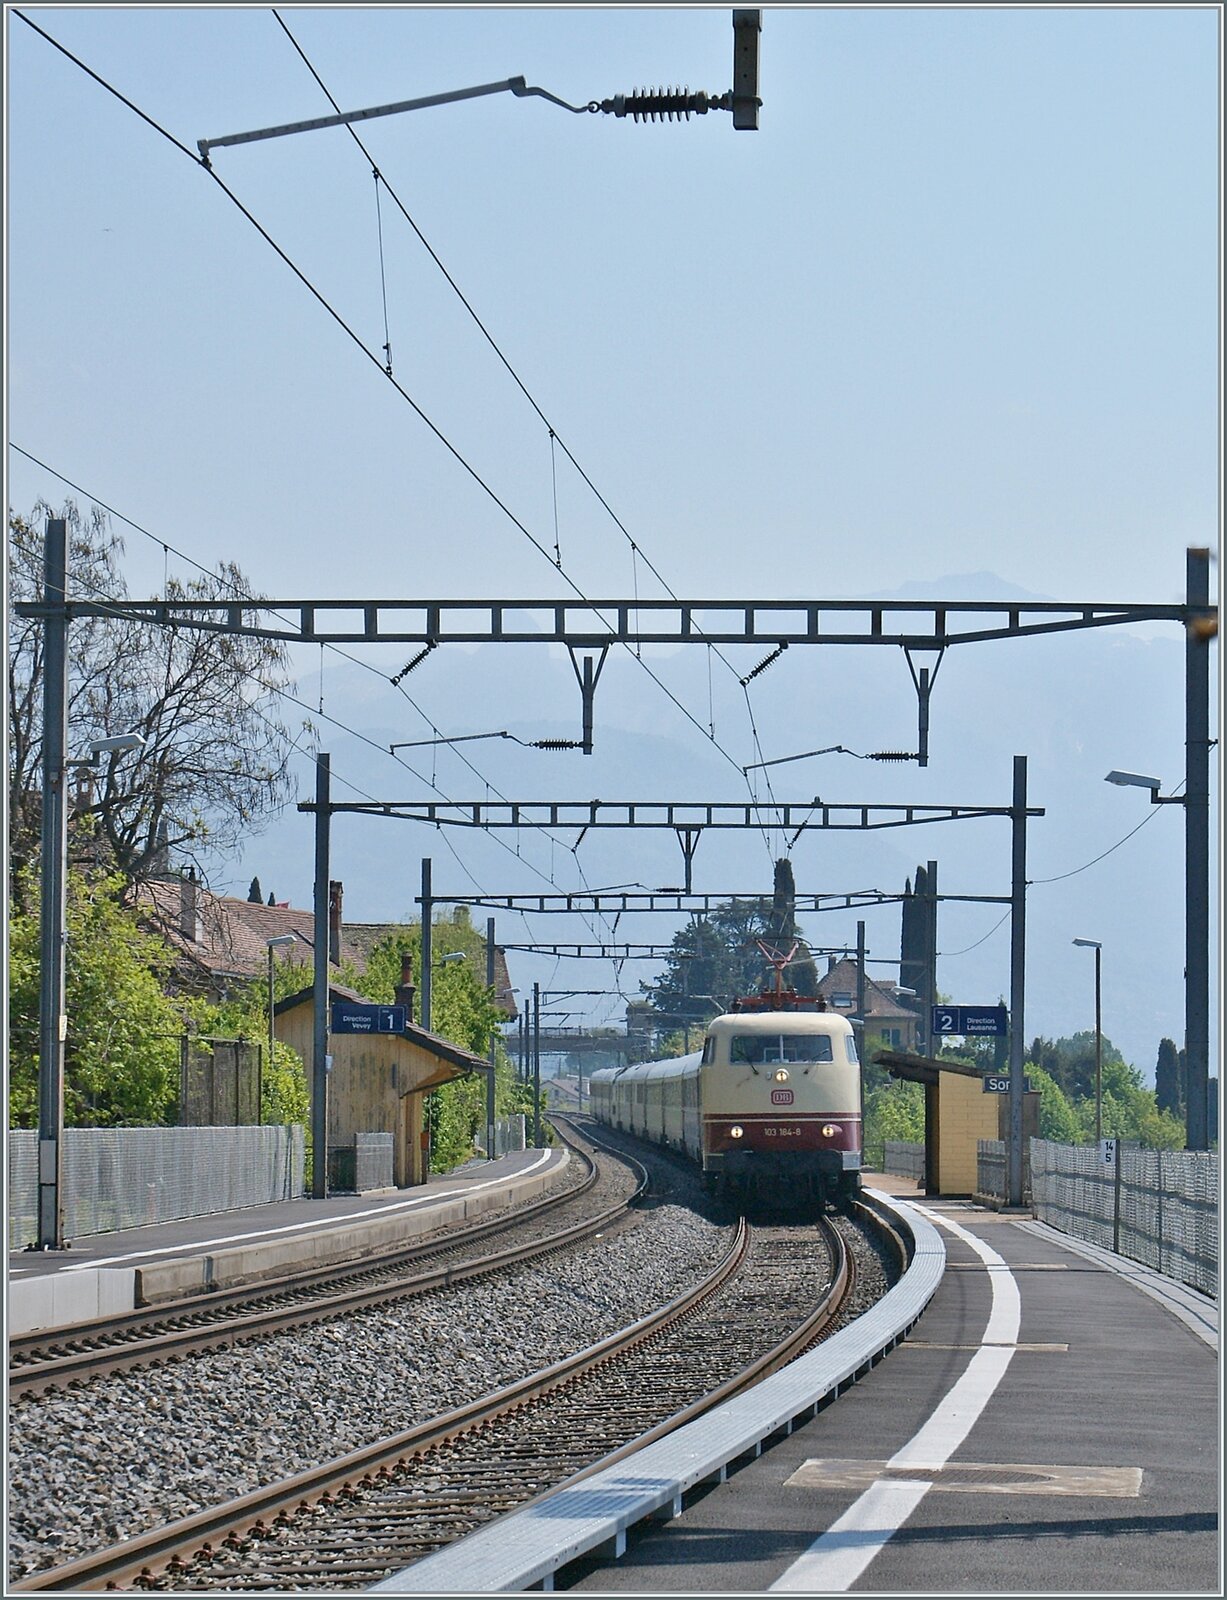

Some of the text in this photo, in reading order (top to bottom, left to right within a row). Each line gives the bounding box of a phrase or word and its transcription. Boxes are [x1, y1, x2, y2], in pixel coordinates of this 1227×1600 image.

[387, 1014, 394, 1029] 1
[941, 1015, 953, 1030] 2
[764, 1127, 802, 1136] 103 184-8
[1105, 1141, 1114, 1151] 14
[1105, 1153, 1112, 1162] 5
